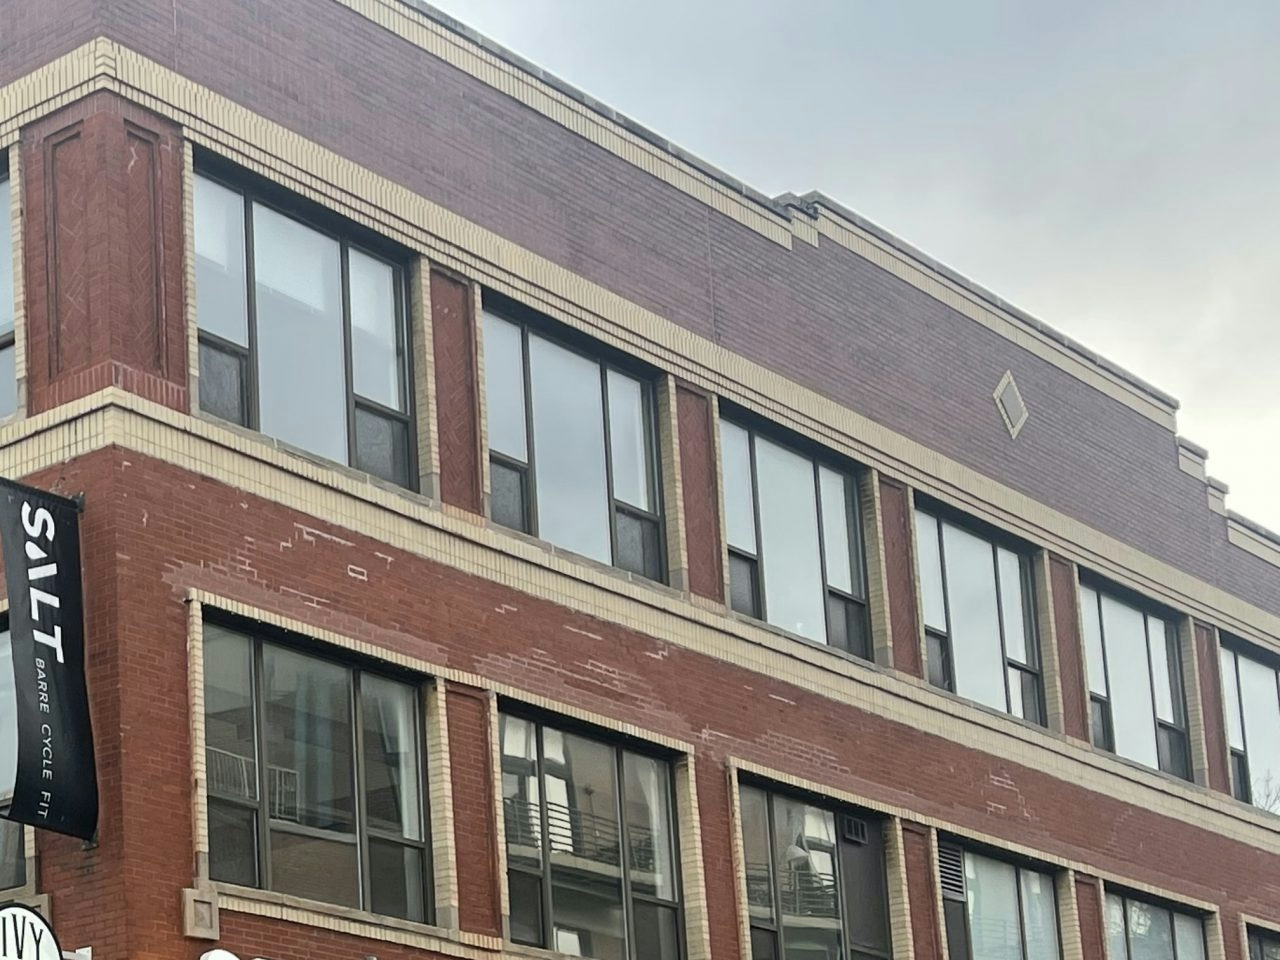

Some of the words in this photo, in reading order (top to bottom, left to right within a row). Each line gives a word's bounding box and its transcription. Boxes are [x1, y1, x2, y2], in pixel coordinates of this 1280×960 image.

[21, 501, 65, 664] SALT
[34, 657, 50, 714] BARRE
[41, 724, 53, 781] CYCLE
[37, 790, 51, 819] FIT
